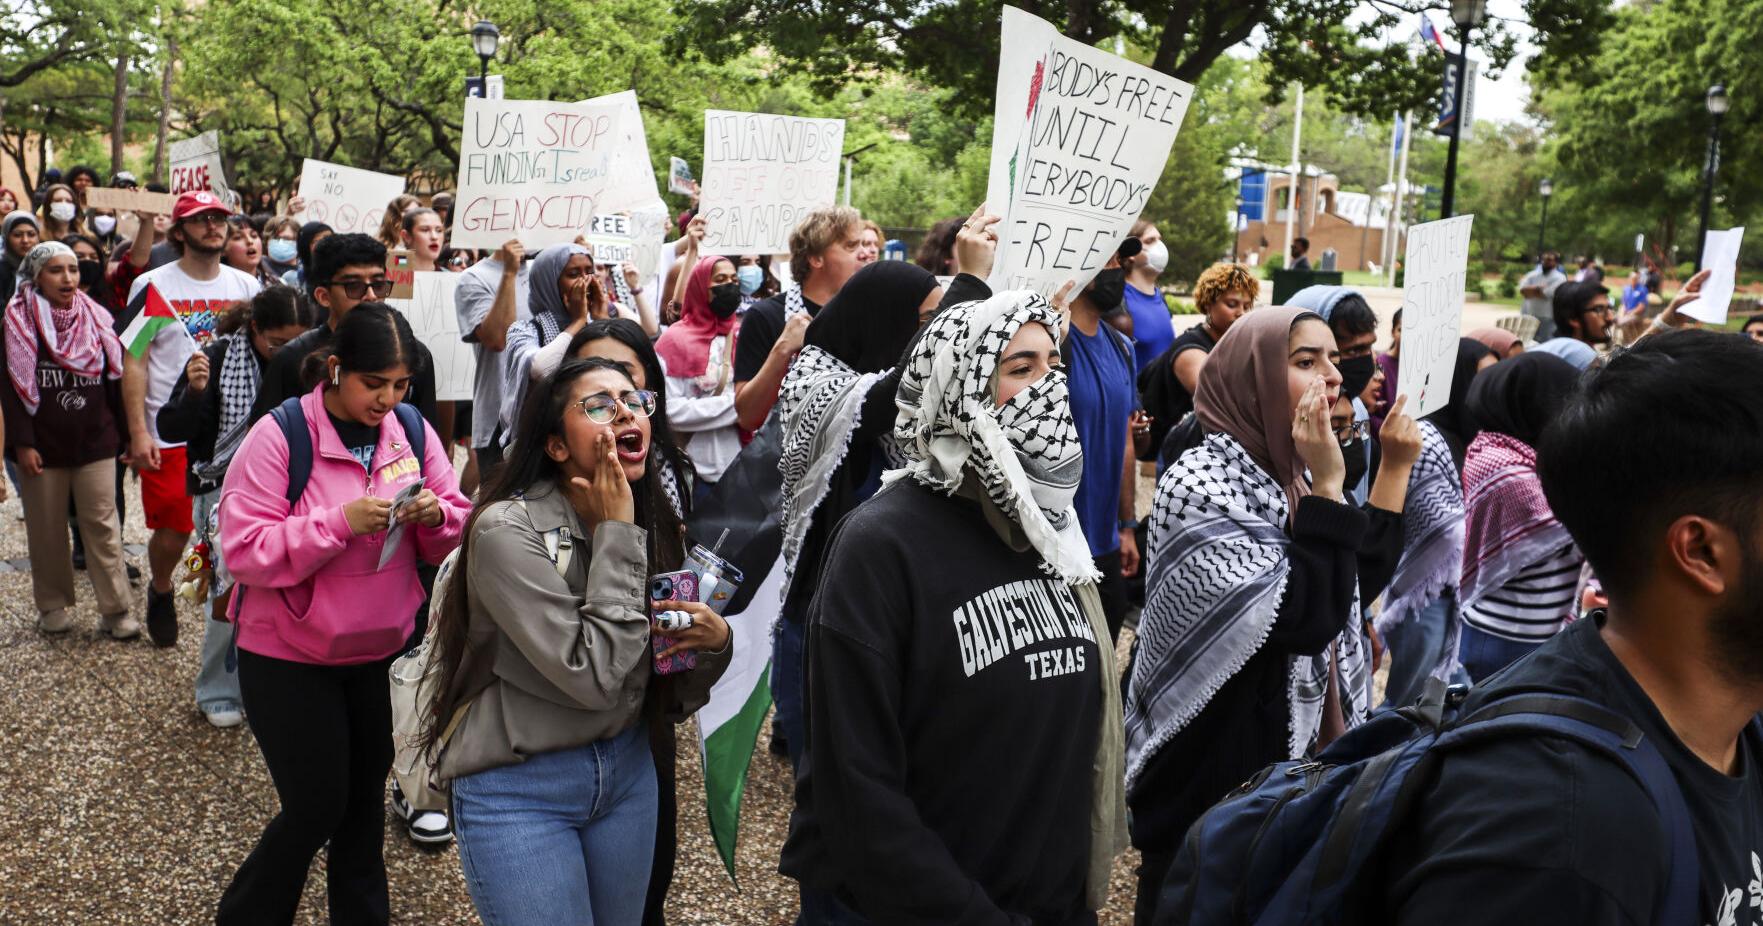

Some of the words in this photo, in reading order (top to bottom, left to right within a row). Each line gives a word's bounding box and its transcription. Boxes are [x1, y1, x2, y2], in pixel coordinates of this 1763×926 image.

[1046, 47, 1118, 105] BODY'S
[1115, 75, 1182, 126] FREE
[475, 111, 525, 149] USA
[537, 112, 610, 150] STOP
[710, 115, 840, 164] HANDS
[1033, 104, 1130, 171] UNTIL
[172, 164, 212, 195] CEASE
[320, 168, 338, 180] SAY
[467, 150, 546, 186] FUNDING
[703, 166, 768, 202] OFF
[324, 183, 344, 196] NO
[591, 216, 626, 234] REE
[700, 203, 808, 250] CAMP
[592, 244, 631, 260] LESTINE
[953, 579, 1066, 678] GALVESTON
[1024, 645, 1086, 681] TEXAS
